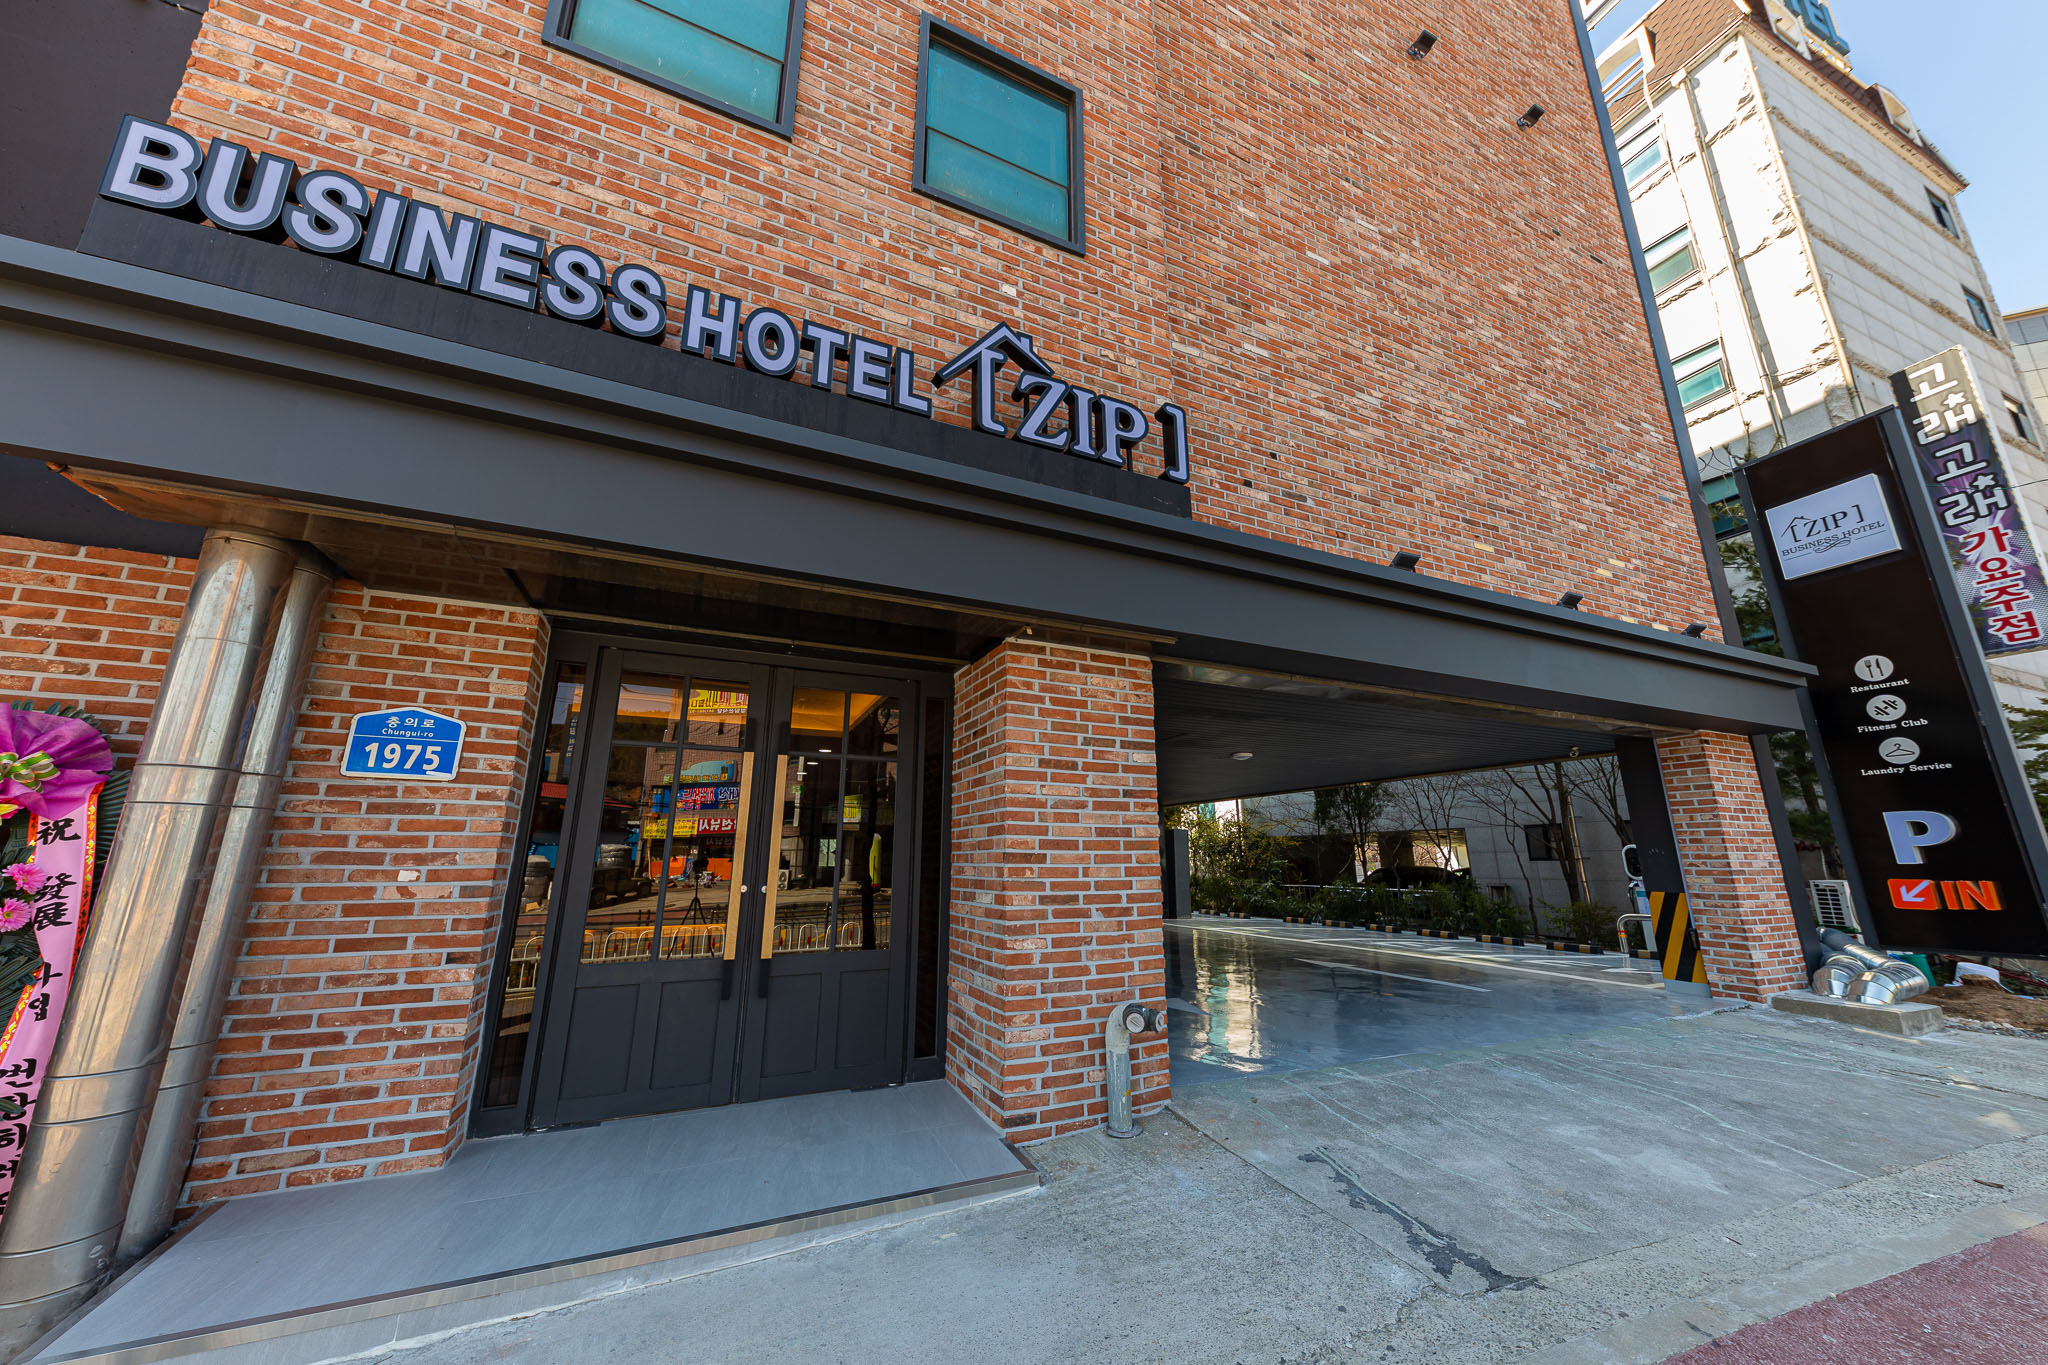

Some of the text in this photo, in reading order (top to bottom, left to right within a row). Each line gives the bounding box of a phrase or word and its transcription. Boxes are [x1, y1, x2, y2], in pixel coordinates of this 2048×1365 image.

[99, 114, 667, 344] BUSINESS
[681, 285, 931, 417] HOTEL
[1908, 362, 2042, 644] 고래고래 가요주점
[1782, 521, 1885, 557] BUSINESS HOTEL
[1850, 678, 1911, 693] Restaurant
[381, 728, 434, 738] Chungui-ro
[386, 716, 436, 728] 충의로
[1857, 718, 1928, 733] Fitness Club
[365, 742, 442, 771] 1975
[1861, 762, 1953, 776] Laundry Service
[35, 817, 82, 846] 祝
[1882, 810, 1957, 865] P
[1940, 880, 2003, 911] IN
